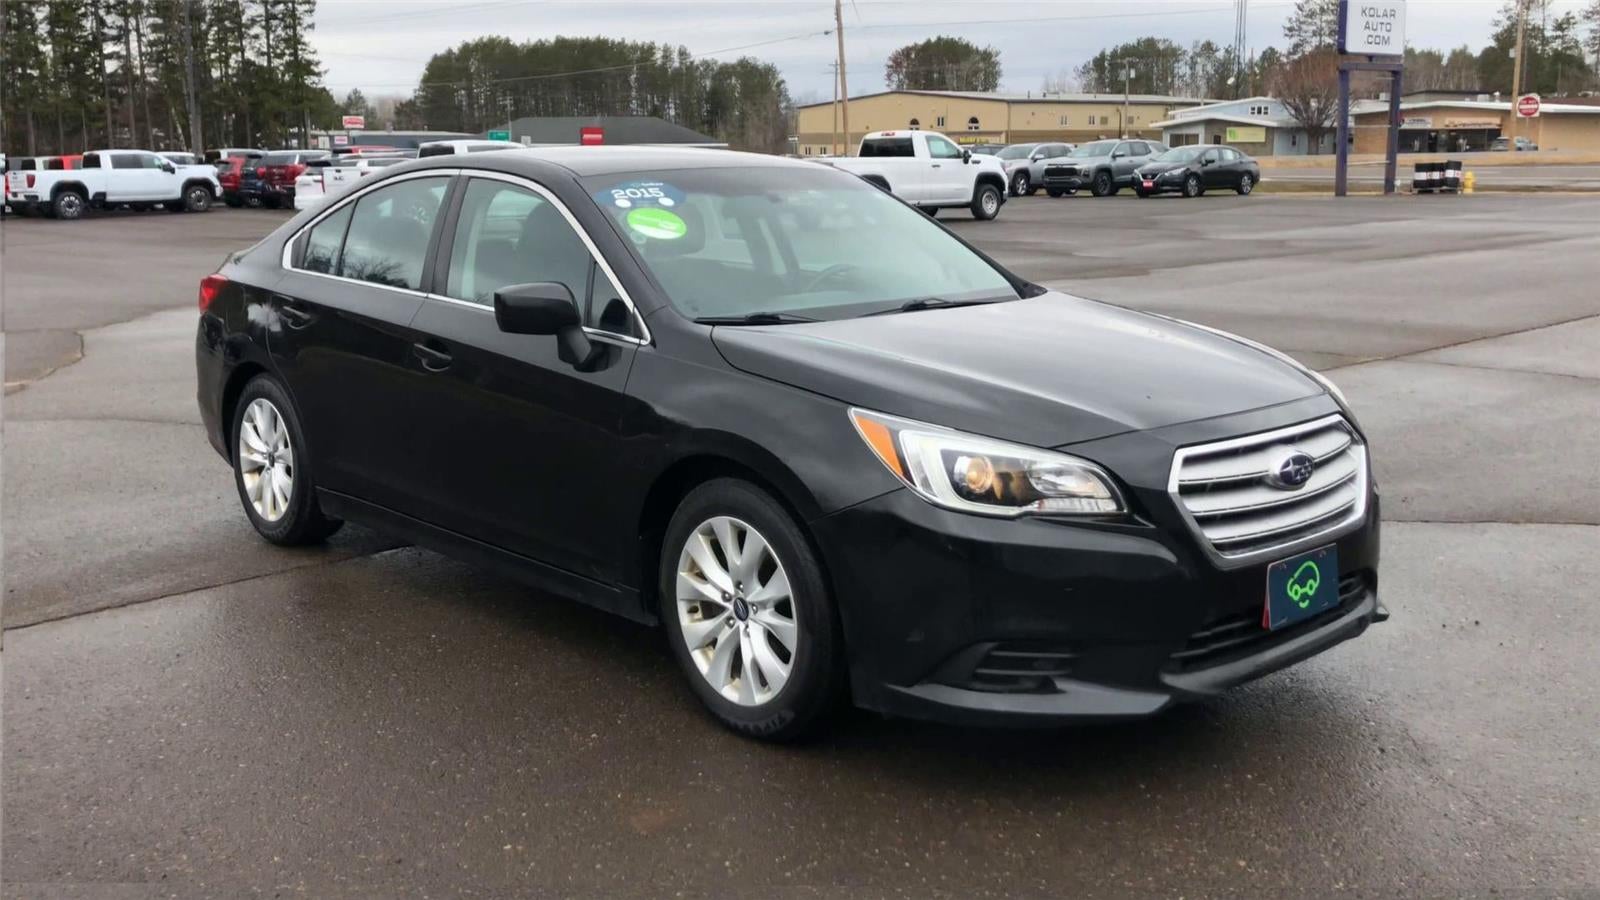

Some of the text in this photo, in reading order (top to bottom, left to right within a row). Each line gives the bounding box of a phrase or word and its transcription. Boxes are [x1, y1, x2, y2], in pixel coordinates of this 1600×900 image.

[1361, 6, 1396, 18] KOLAR
[1364, 20, 1392, 32] AUTO
[1364, 34, 1391, 46] .COM
[611, 187, 665, 199] 2015
